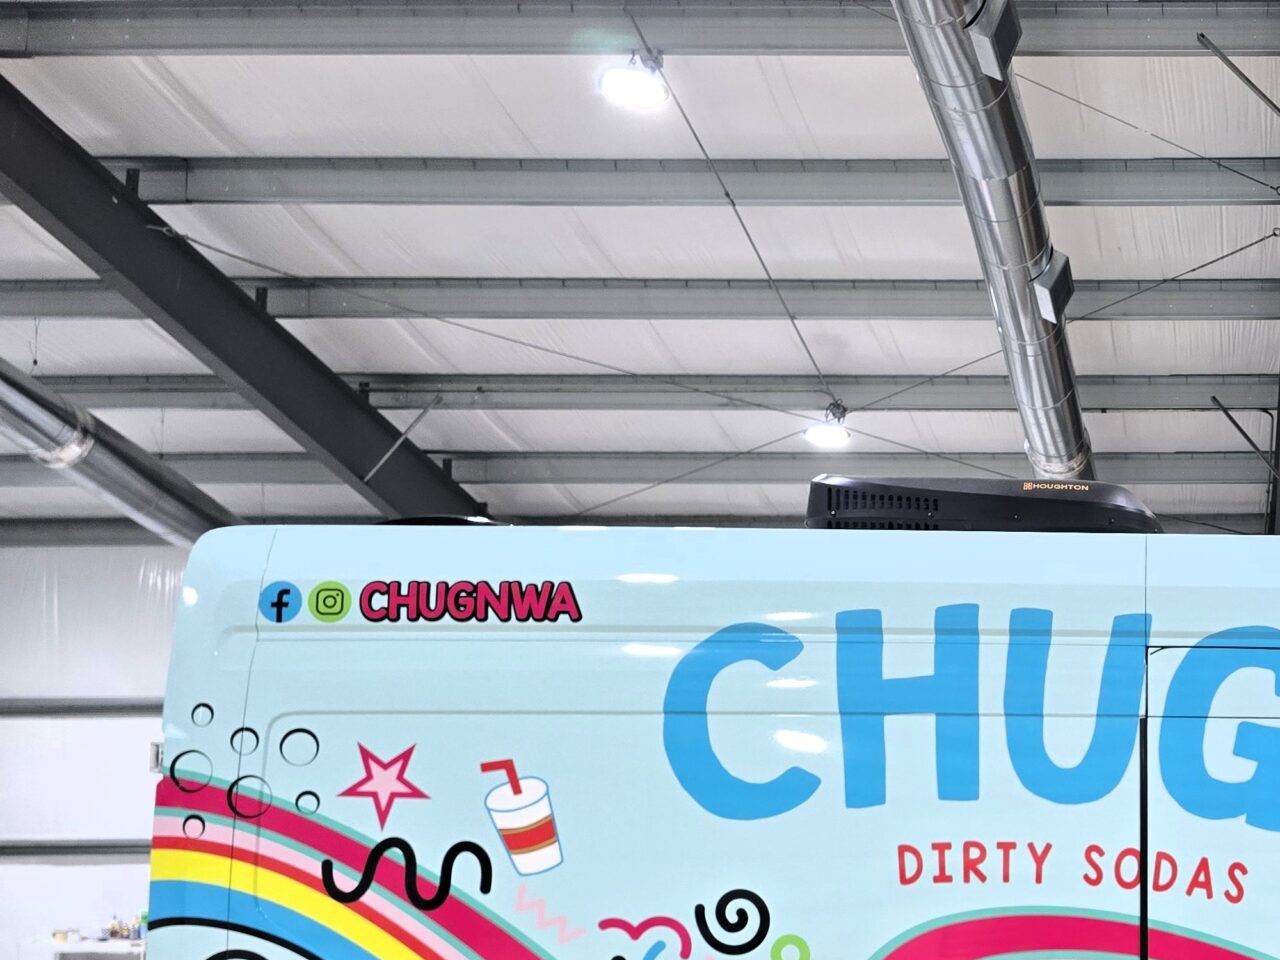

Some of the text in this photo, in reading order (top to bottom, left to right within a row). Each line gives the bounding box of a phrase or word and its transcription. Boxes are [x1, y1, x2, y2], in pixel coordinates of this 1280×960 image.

[1032, 483, 1089, 491] HOUGHTON
[359, 580, 583, 622] CHUGNWA
[897, 841, 1248, 904] DIRTY SODAS
